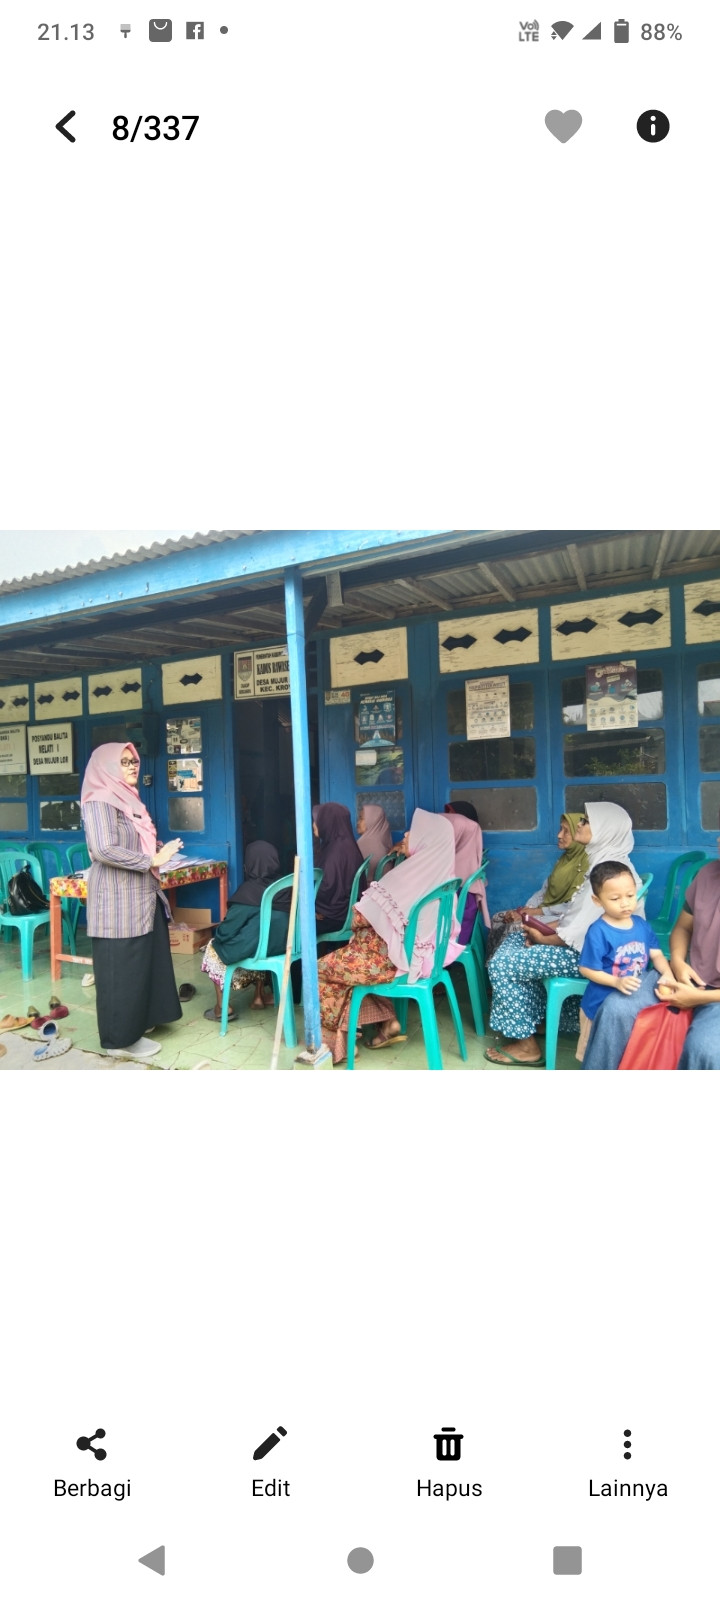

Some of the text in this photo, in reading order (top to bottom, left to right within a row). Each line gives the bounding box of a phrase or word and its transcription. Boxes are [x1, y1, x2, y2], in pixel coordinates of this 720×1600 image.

[32, 732, 68, 742] POSYANDU BALITA
[33, 757, 43, 765] DESA
